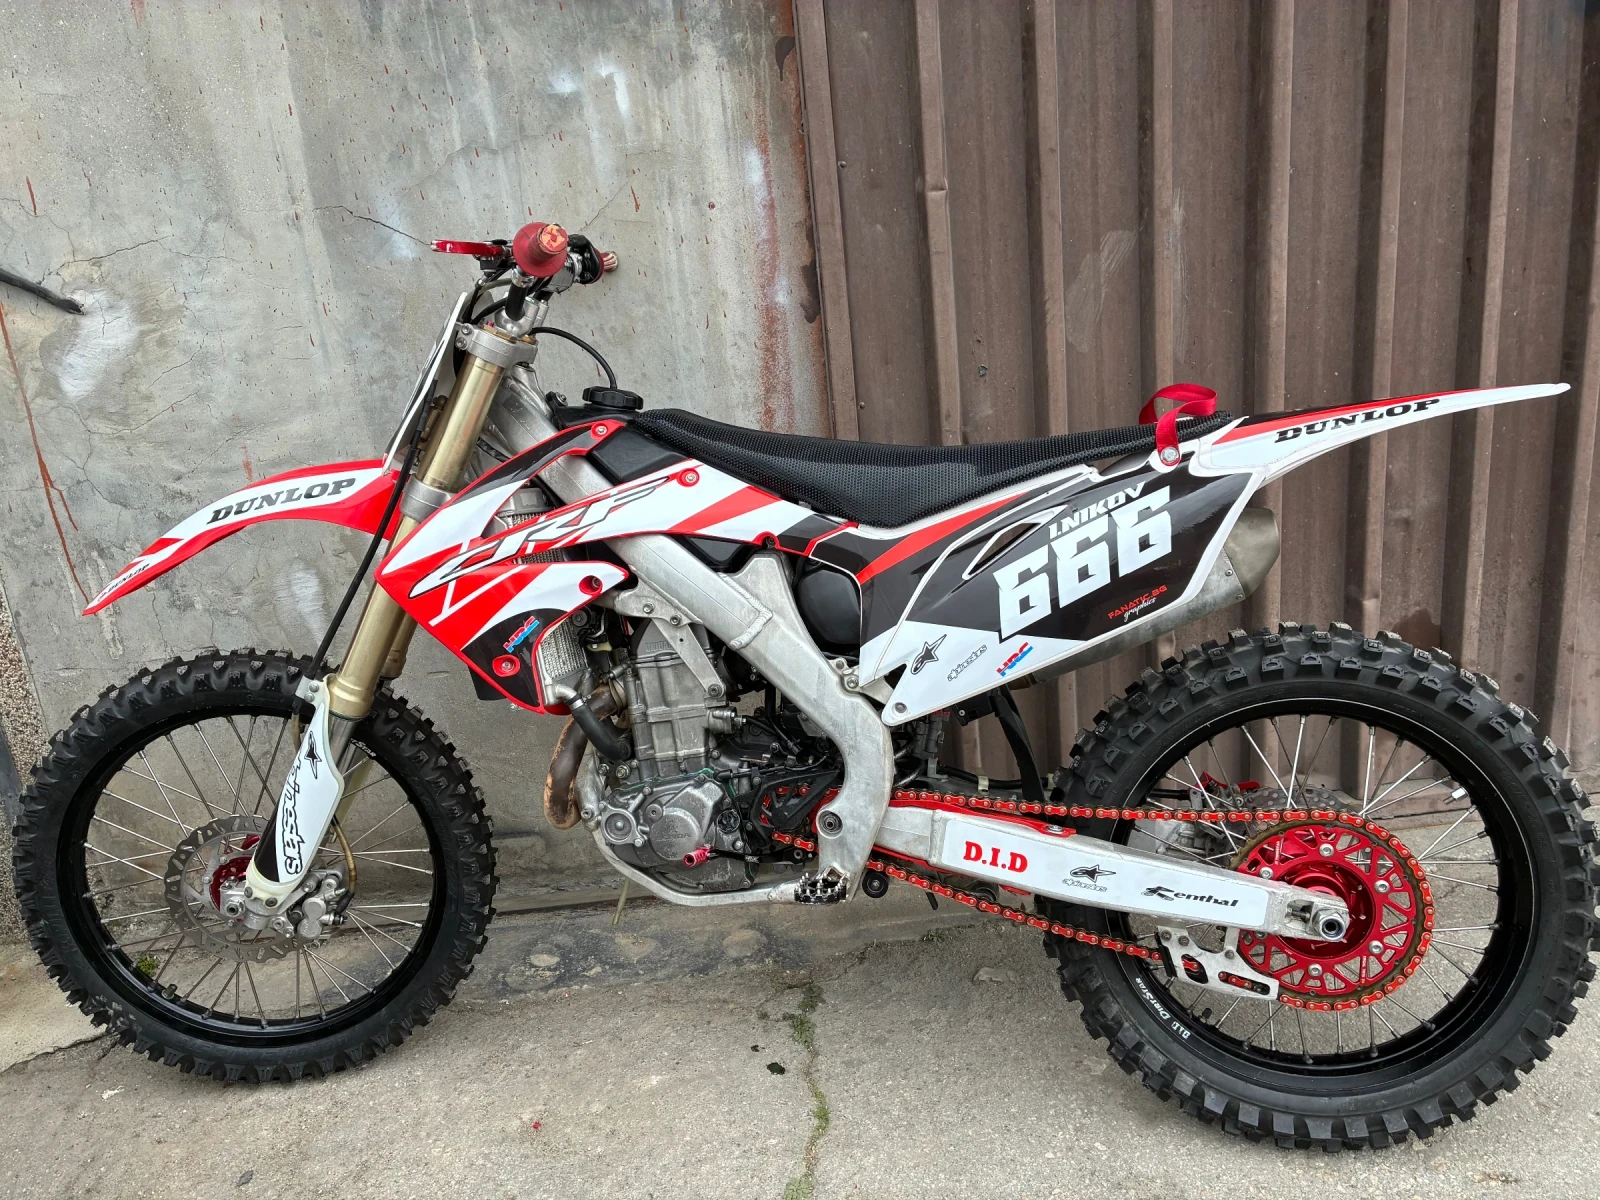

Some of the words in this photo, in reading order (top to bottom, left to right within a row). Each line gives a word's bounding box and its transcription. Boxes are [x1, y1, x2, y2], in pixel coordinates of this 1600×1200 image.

[1274, 398, 1440, 443] DUNLOP
[206, 477, 356, 525] DUNLOP
[1049, 481, 1145, 539] I.NIKOV
[992, 485, 1172, 640] 666
[1108, 584, 1168, 619] FANATIC.BG
[1123, 597, 1157, 622] graphics
[963, 841, 1028, 873] D.I.D
